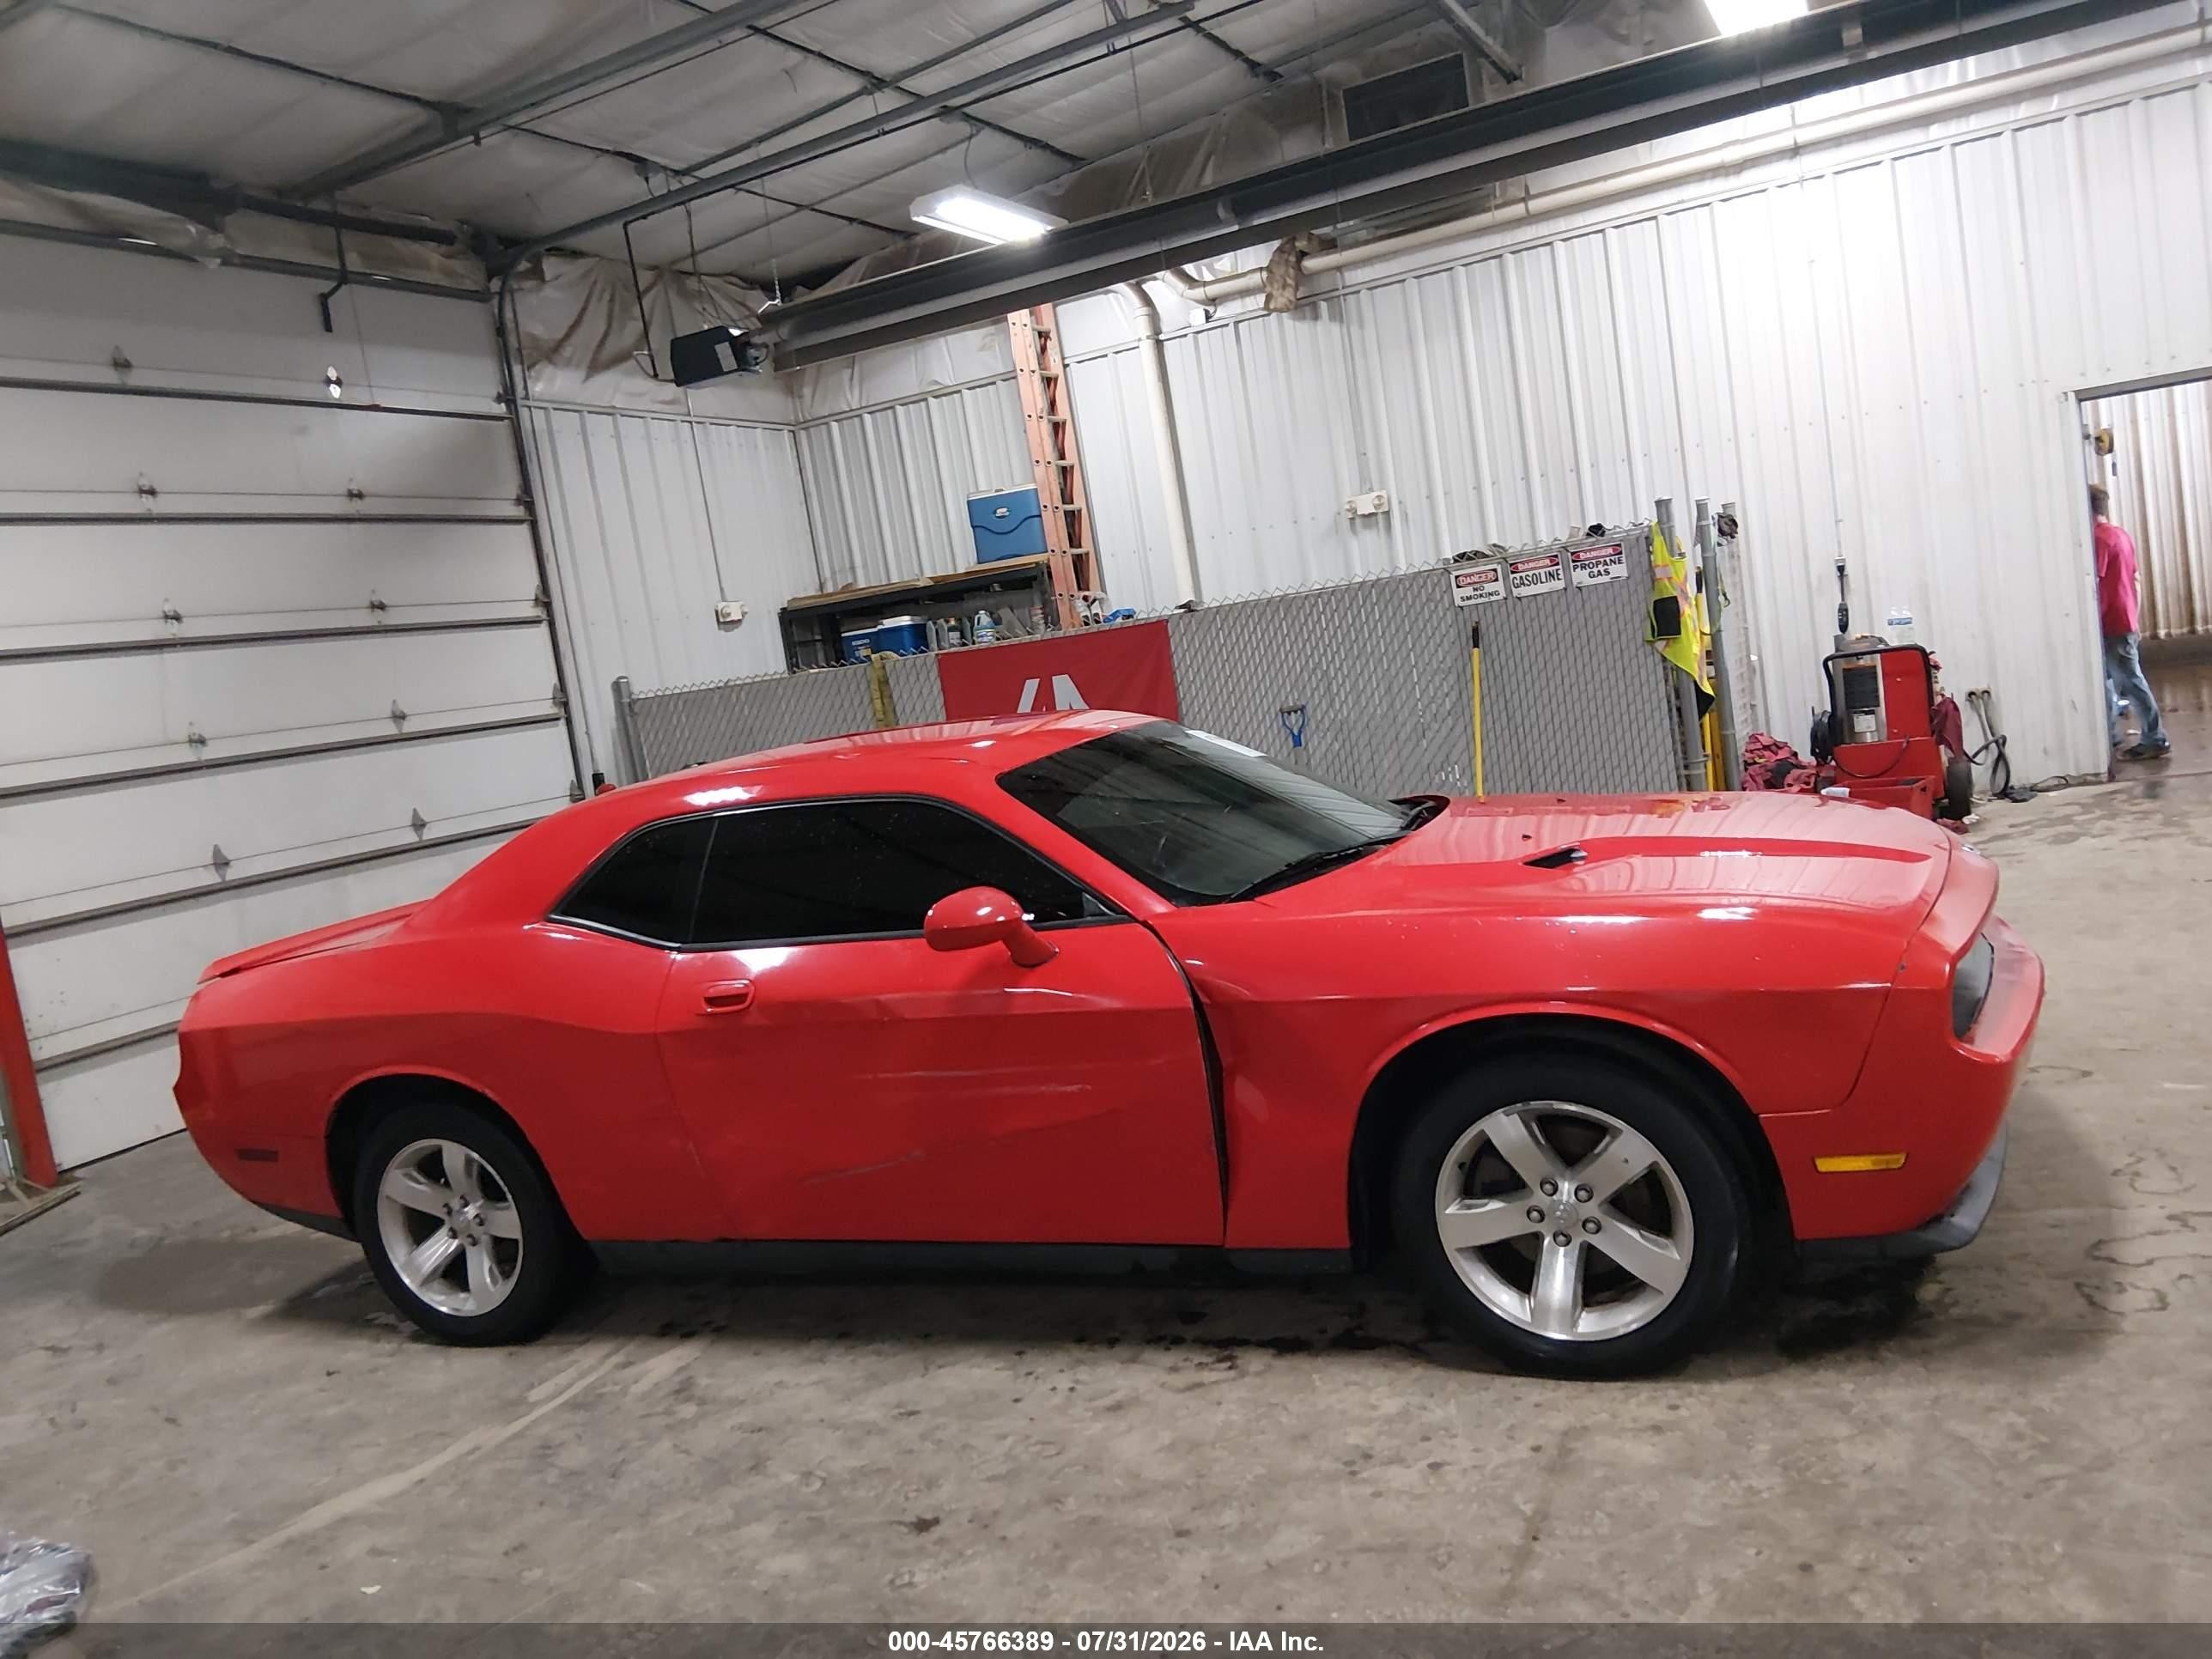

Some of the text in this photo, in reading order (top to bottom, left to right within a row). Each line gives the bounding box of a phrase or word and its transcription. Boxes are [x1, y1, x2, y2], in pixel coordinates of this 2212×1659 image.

[1579, 547, 1613, 559] DANGER
[1517, 557, 1551, 570] DANGER
[1572, 556, 1625, 572] PROPANE
[1459, 572, 1495, 585] DANGER
[1511, 568, 1563, 589] GASOLINE
[1588, 568, 1611, 579] GAS
[1459, 590, 1501, 603] SMOKING
